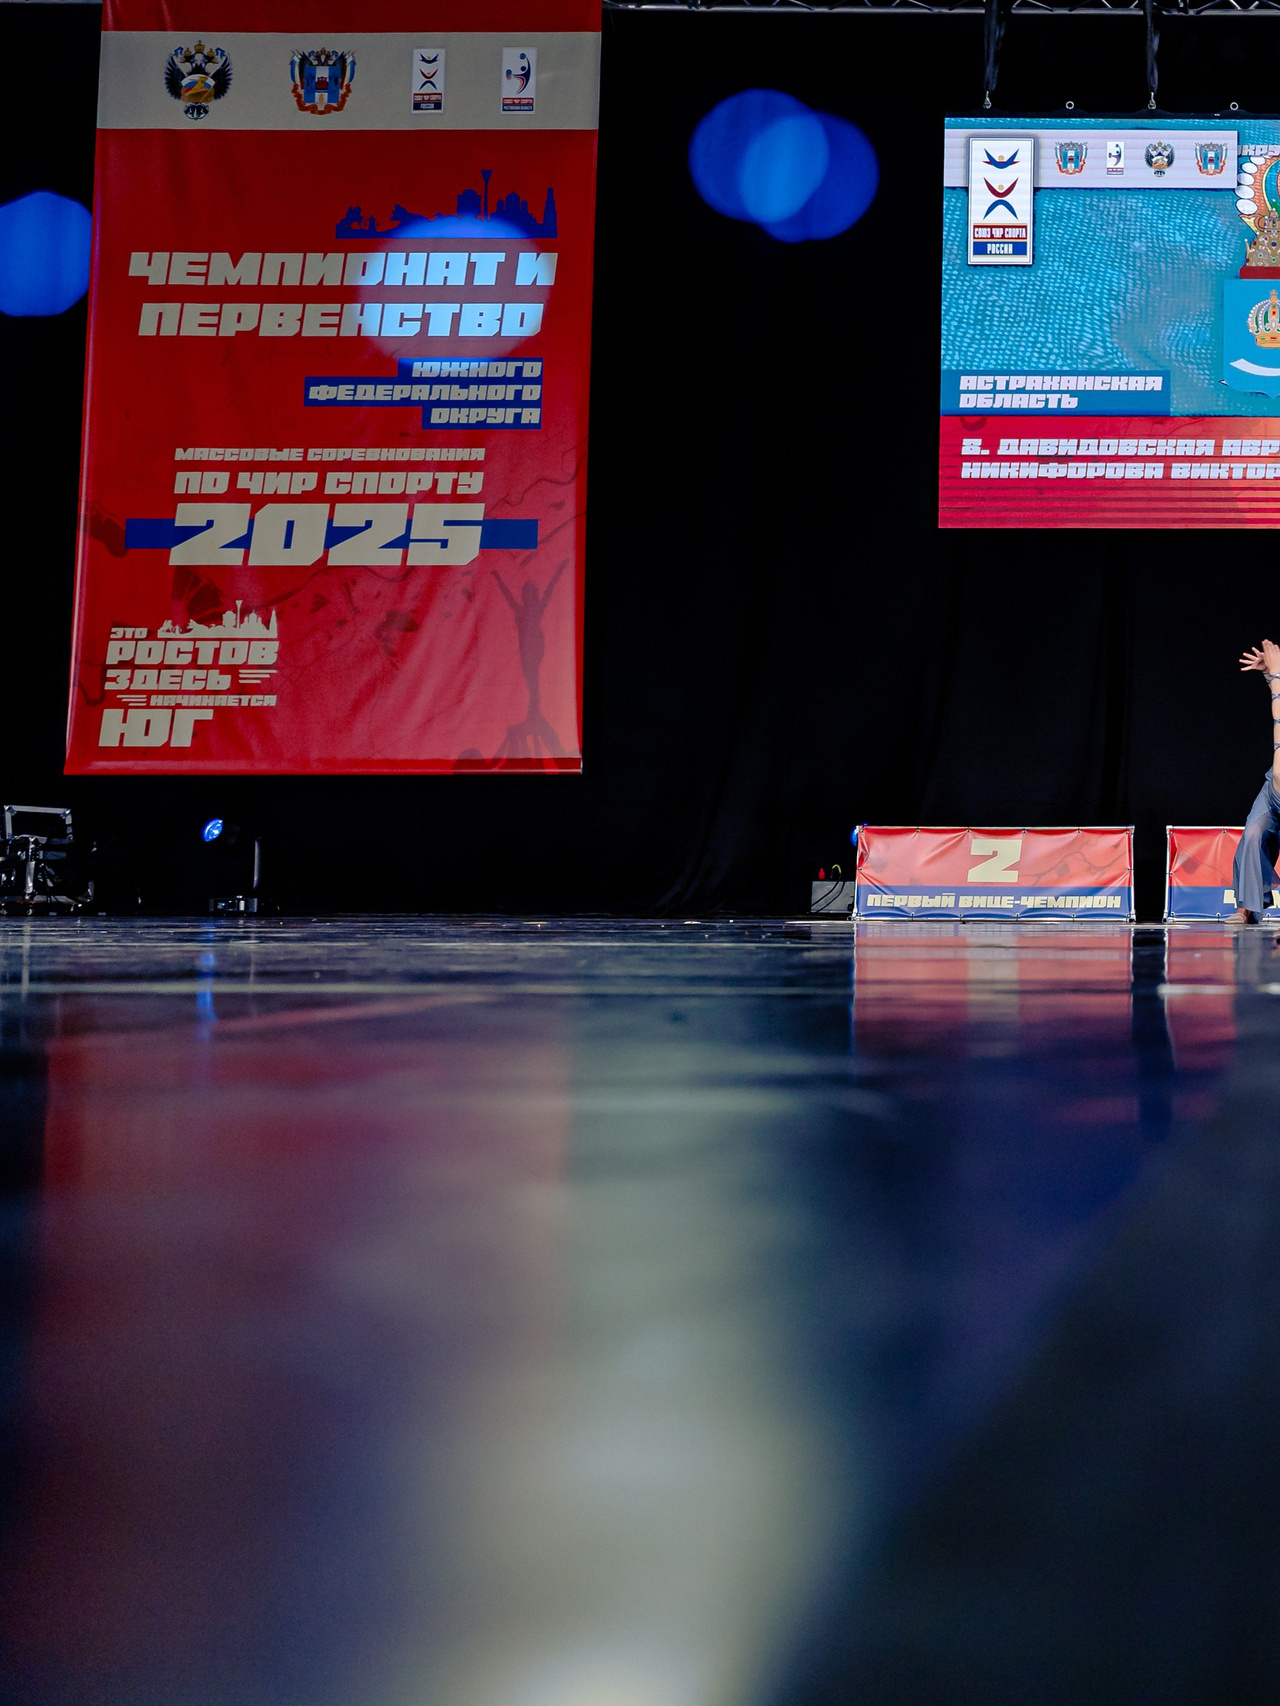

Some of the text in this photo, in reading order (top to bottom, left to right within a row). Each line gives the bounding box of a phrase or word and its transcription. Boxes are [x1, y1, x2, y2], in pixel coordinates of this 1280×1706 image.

[987, 243, 1013, 254] РОССИИ
[128, 252, 558, 286] ЧЕМПИОНАТ И
[138, 303, 544, 337] ПЕРВЕНСТВО
[412, 362, 542, 378] ЮЖНОГО
[959, 375, 1163, 391] АСТРАХАНСКАЯ
[308, 384, 542, 401] ФЕДЕРАЛЬНОГО
[959, 393, 1078, 408] ОБЛАСТЬ
[430, 408, 540, 424] ОКРУГА
[174, 448, 485, 461] МАССОВЫЕ СОРЕВНОВАНИЯ
[961, 438, 990, 456] 8.
[997, 438, 1215, 456] ДАВИДОВСКАЯ
[961, 462, 1164, 479] НИКИФОРОВА
[174, 471, 484, 495] ПО ЧИР СПОРТУ
[168, 502, 486, 566] 2025
[109, 627, 148, 639] ЭТО
[105, 640, 279, 665] РОСТОВ
[104, 669, 231, 691] ЗДЕСЬ
[150, 695, 277, 707] НАЧИНАЕТСЯ
[98, 708, 214, 747] ЮГ
[967, 839, 1022, 883] 2
[867, 892, 1121, 909] ПЕРВЫЙ ВИЦЕ-ЧЕМПИОН
